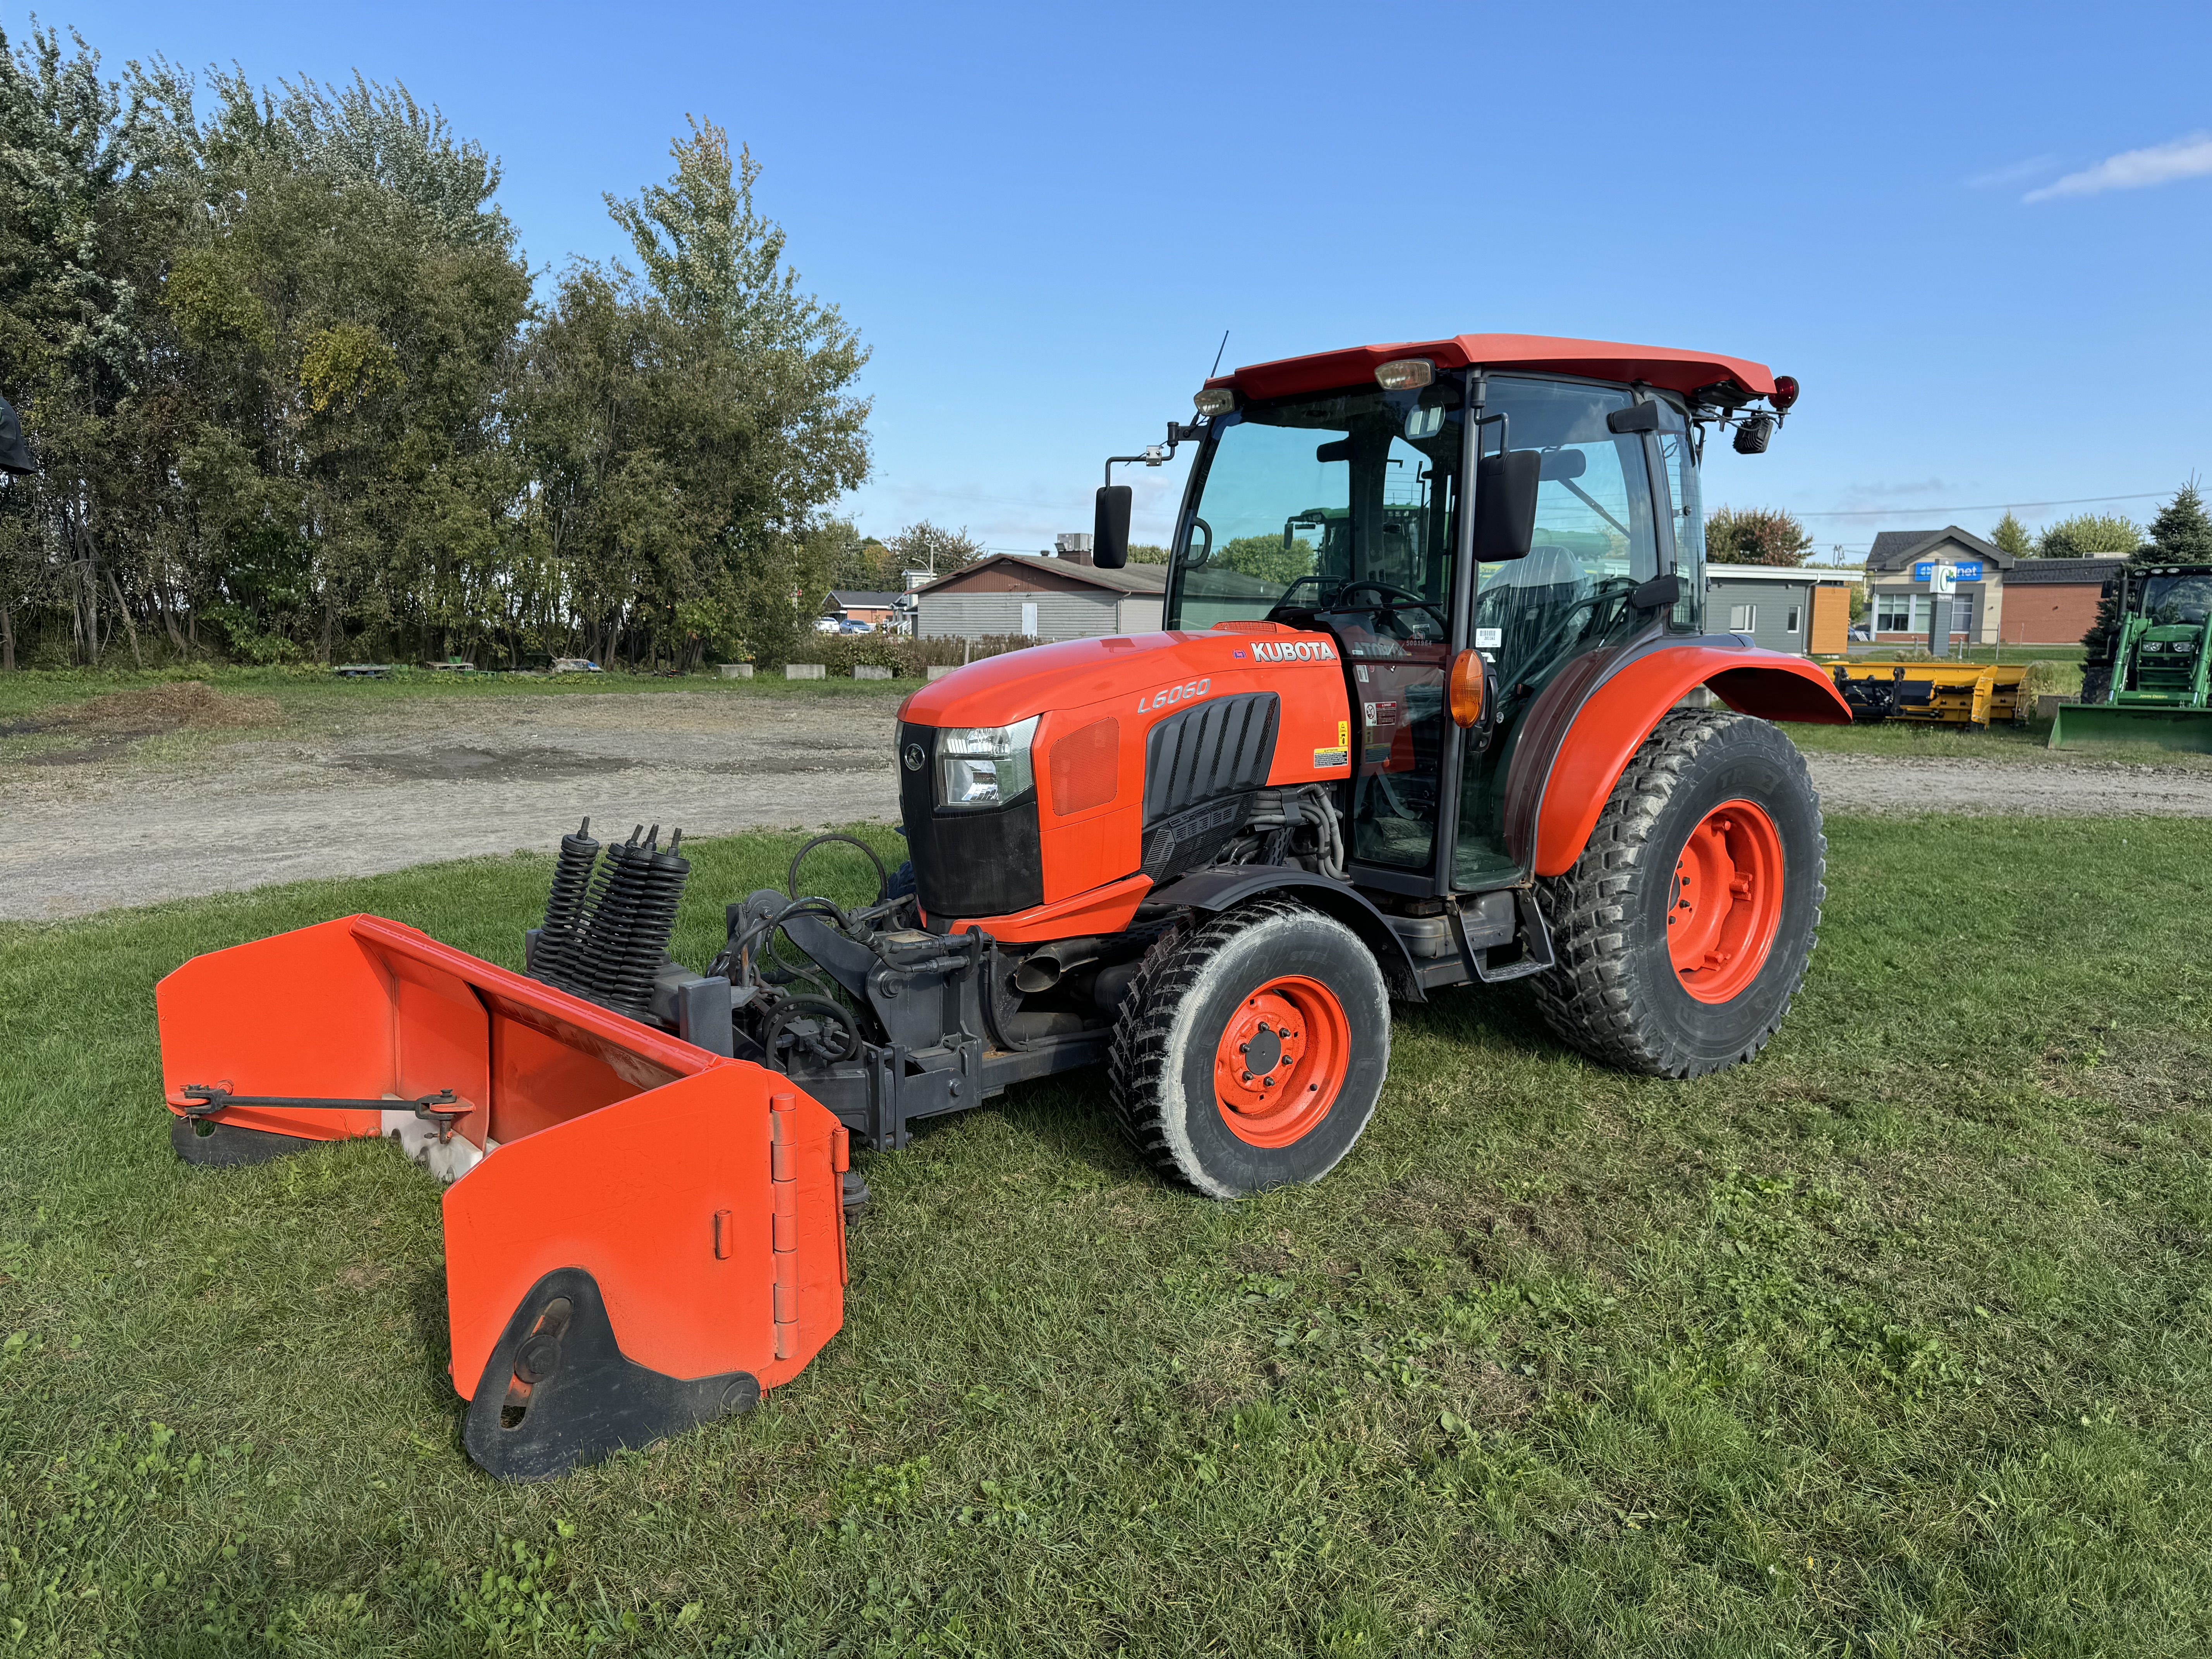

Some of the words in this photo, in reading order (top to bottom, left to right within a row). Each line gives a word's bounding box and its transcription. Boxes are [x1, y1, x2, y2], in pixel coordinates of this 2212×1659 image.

[1957, 566, 1977, 577] net
[1249, 641, 1338, 662] KUBOTA
[1137, 678, 1211, 714] L6060
